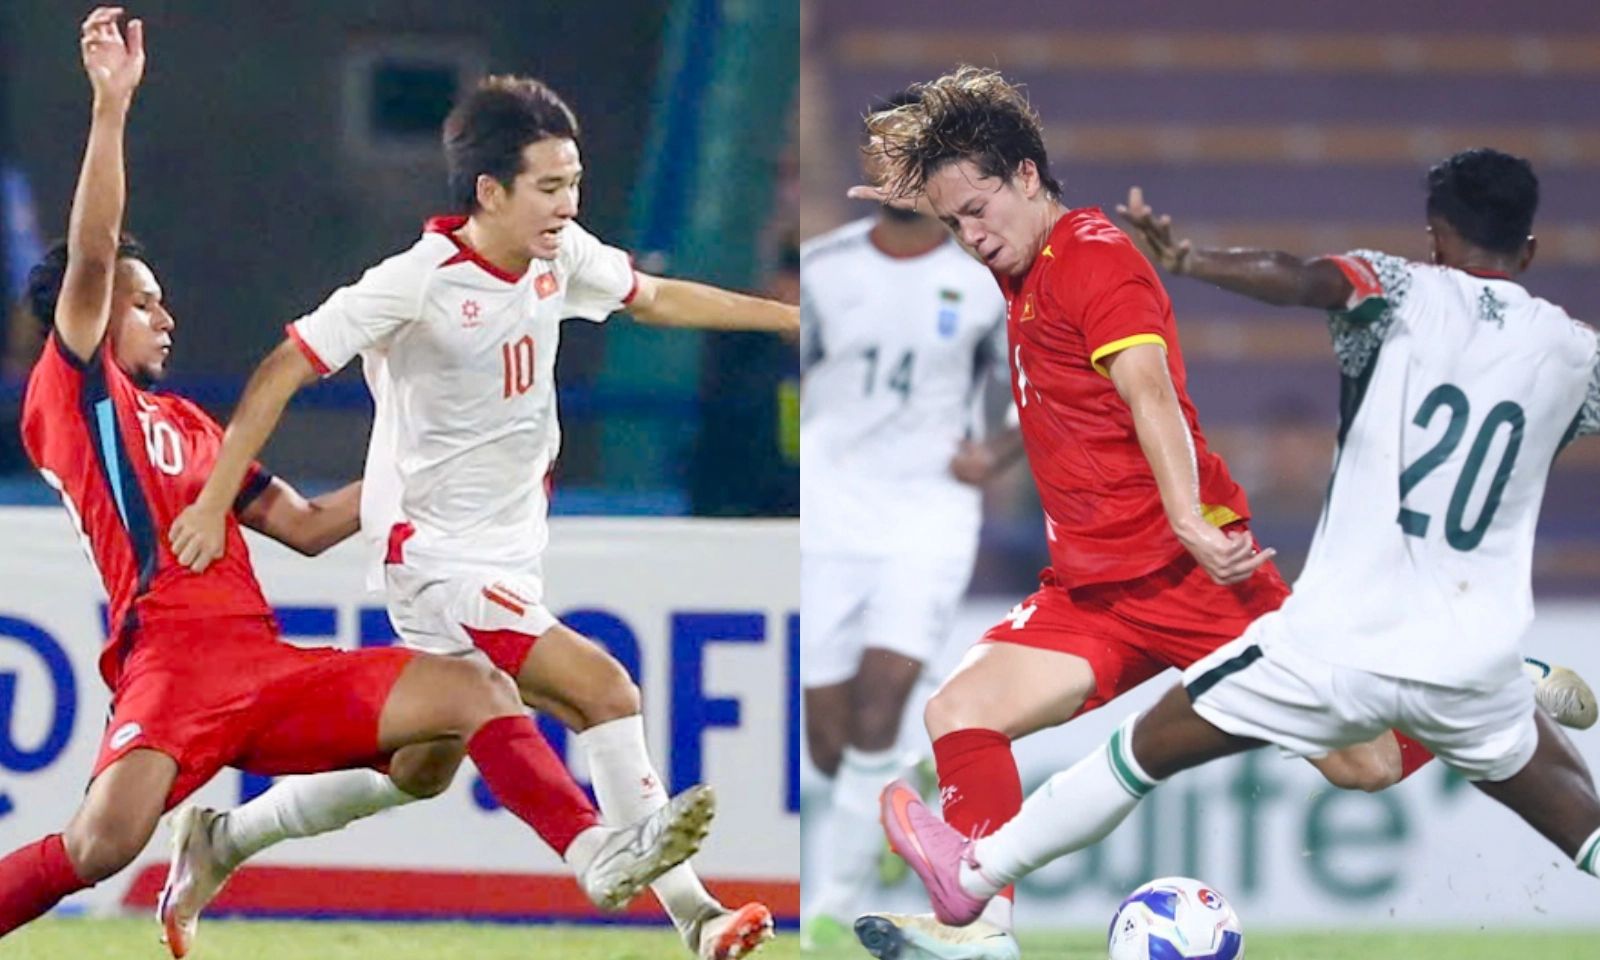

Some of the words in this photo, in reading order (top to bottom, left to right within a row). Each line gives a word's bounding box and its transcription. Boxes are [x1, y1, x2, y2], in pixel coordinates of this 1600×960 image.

[502, 334, 535, 400] 10
[863, 347, 915, 401] 14
[136, 410, 184, 477] 10
[1396, 383, 1527, 552] 20
